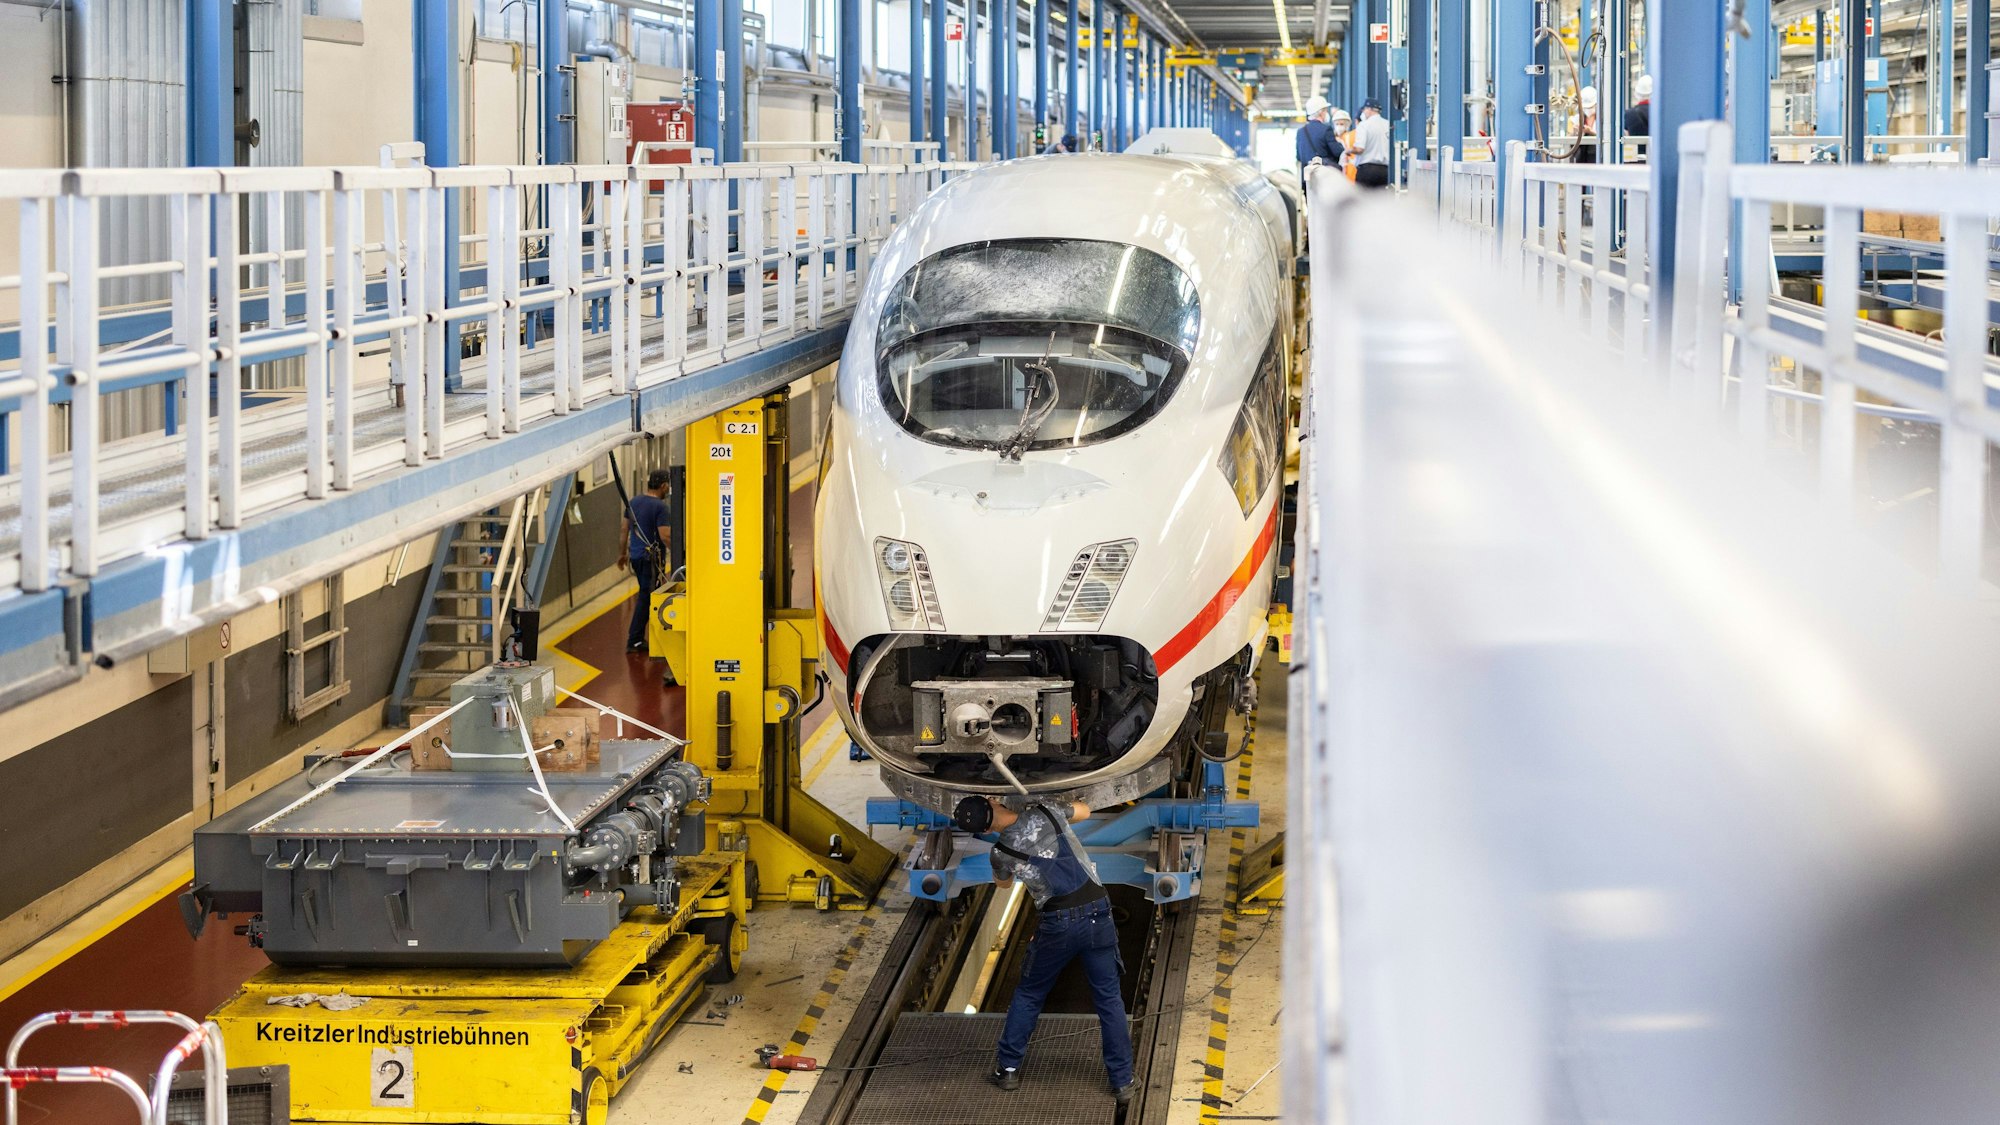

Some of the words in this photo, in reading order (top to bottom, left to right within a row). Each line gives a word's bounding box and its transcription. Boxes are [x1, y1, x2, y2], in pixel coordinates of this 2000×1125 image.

[727, 423, 736, 434] C
[741, 423, 756, 434] 2.1
[711, 447, 731, 458] 20t
[722, 494, 732, 561] NEUERO
[257, 1022, 355, 1042] Kreitzler
[358, 1024, 529, 1046] Industriebühnen
[379, 1060, 405, 1099] 2
